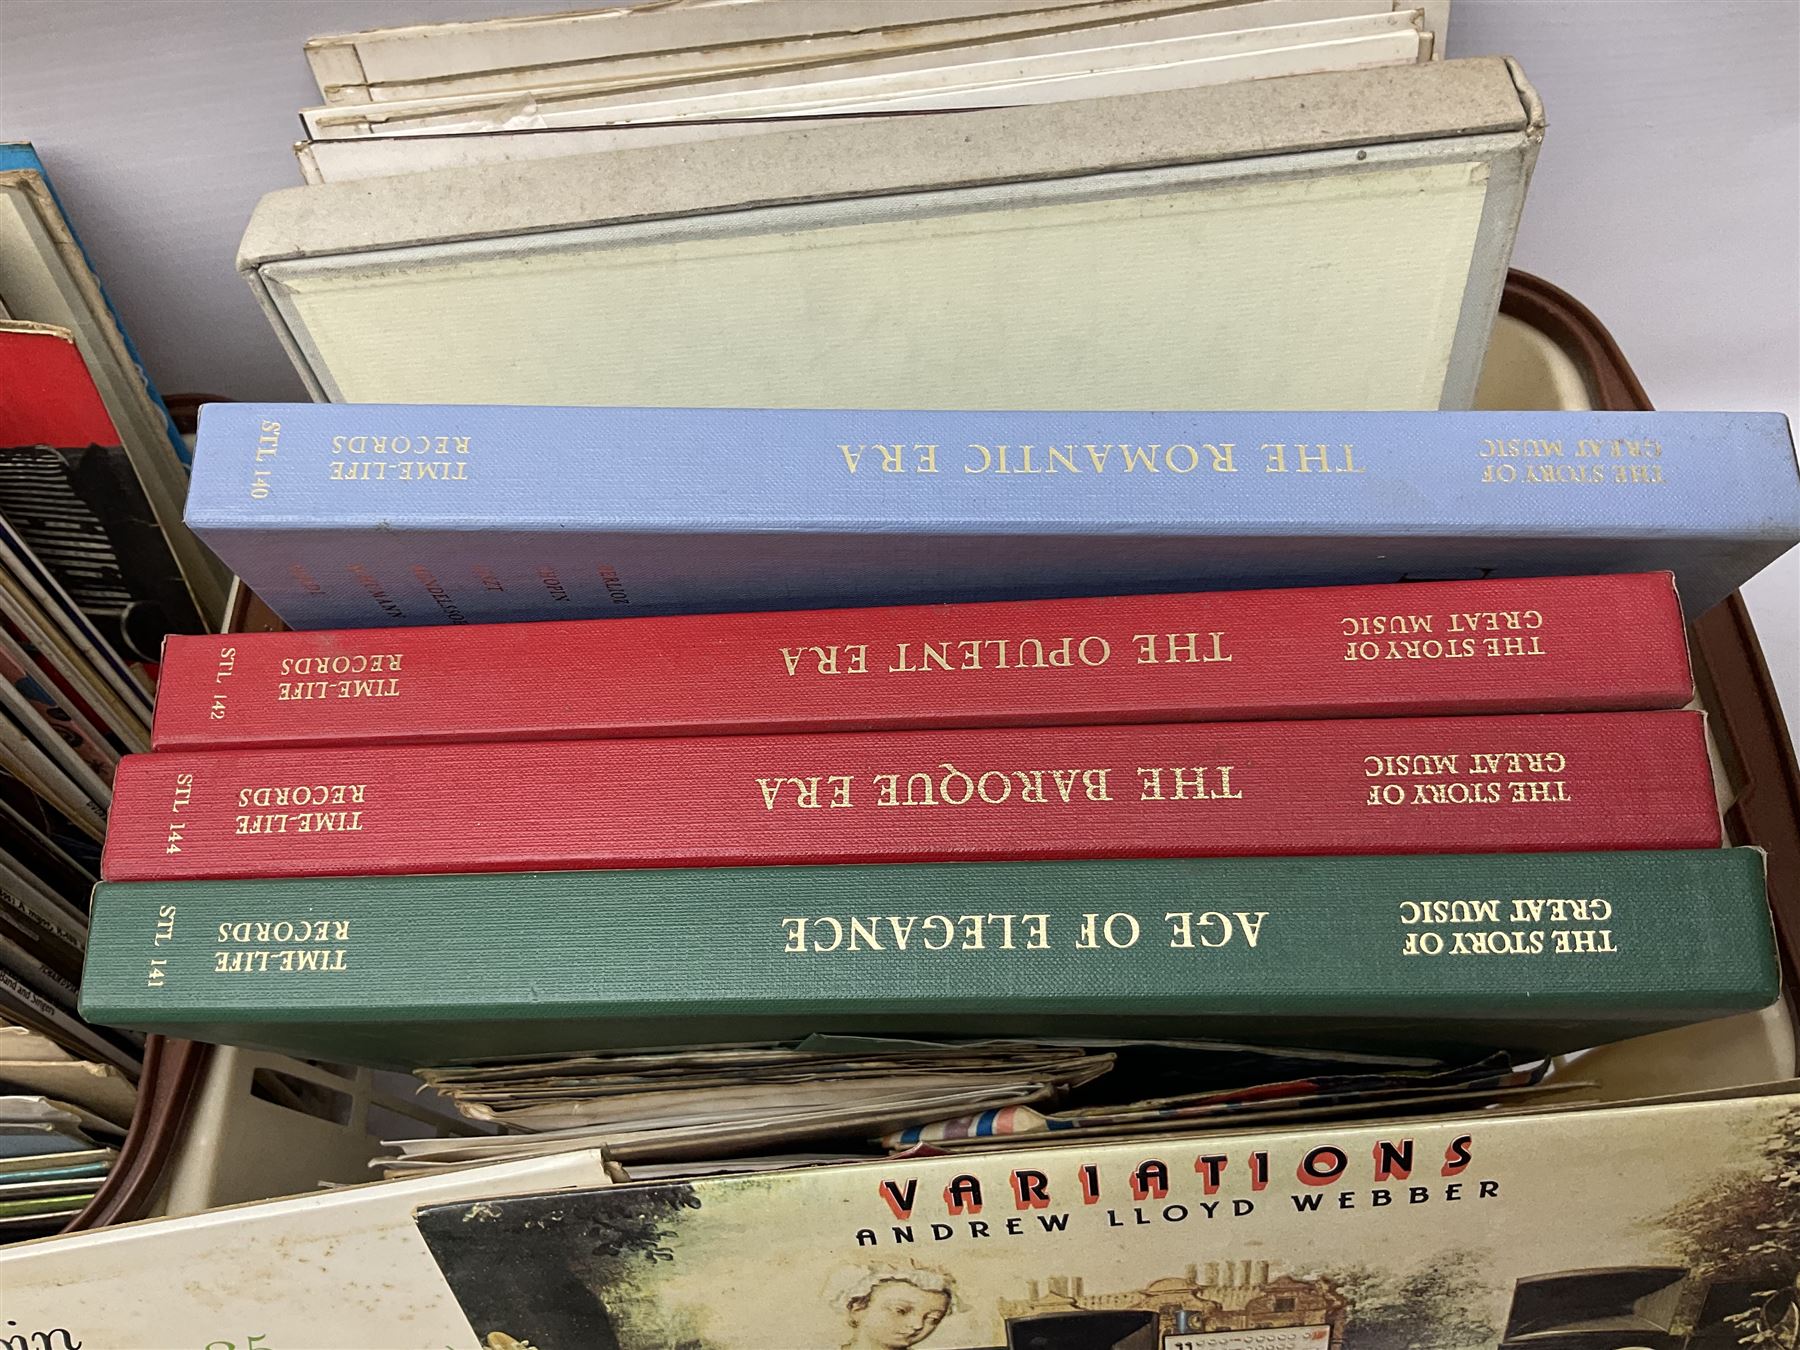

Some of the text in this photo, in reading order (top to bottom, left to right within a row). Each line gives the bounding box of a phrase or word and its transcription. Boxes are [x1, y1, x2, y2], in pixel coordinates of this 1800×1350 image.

[331, 436, 471, 454] RECORDS
[1479, 438, 1662, 459] GREAT MUSIC
[250, 420, 281, 500] STL 140
[329, 462, 469, 481] TIME-LIFE
[838, 443, 1366, 474] THE ROMANTIC ERA
[1482, 463, 1666, 484] THE STORY OF
[1341, 610, 1544, 636] GREAT MUSIC
[779, 631, 1233, 677] THE OPULENT ERA
[1344, 636, 1548, 662] THE STORY OF
[281, 654, 404, 676] RECORDS
[210, 647, 236, 720] STL 142
[278, 678, 400, 701] TIME-LIFE
[1363, 752, 1567, 777] GREAT MUSIC
[238, 784, 368, 807] RECORDS
[755, 763, 1244, 811] THE BAROQUE ERA
[1366, 781, 1572, 806] THE STORY OF
[166, 773, 193, 855] STL 144
[235, 811, 364, 835] TIME-LIFE
[1399, 898, 1613, 924] GREAT MUSIC
[218, 920, 351, 942] RECORDS
[781, 911, 1270, 953] AGE OF ELEGANCE
[1402, 930, 1618, 956] THE STORY OF
[148, 905, 177, 988] STL 141
[214, 949, 348, 973] TIME-LIFE
[17, 982, 32, 999] and
[880, 1134, 1474, 1220] VARIATIONS
[856, 1181, 1501, 1247] ANDREW LLOYD WEBBER
